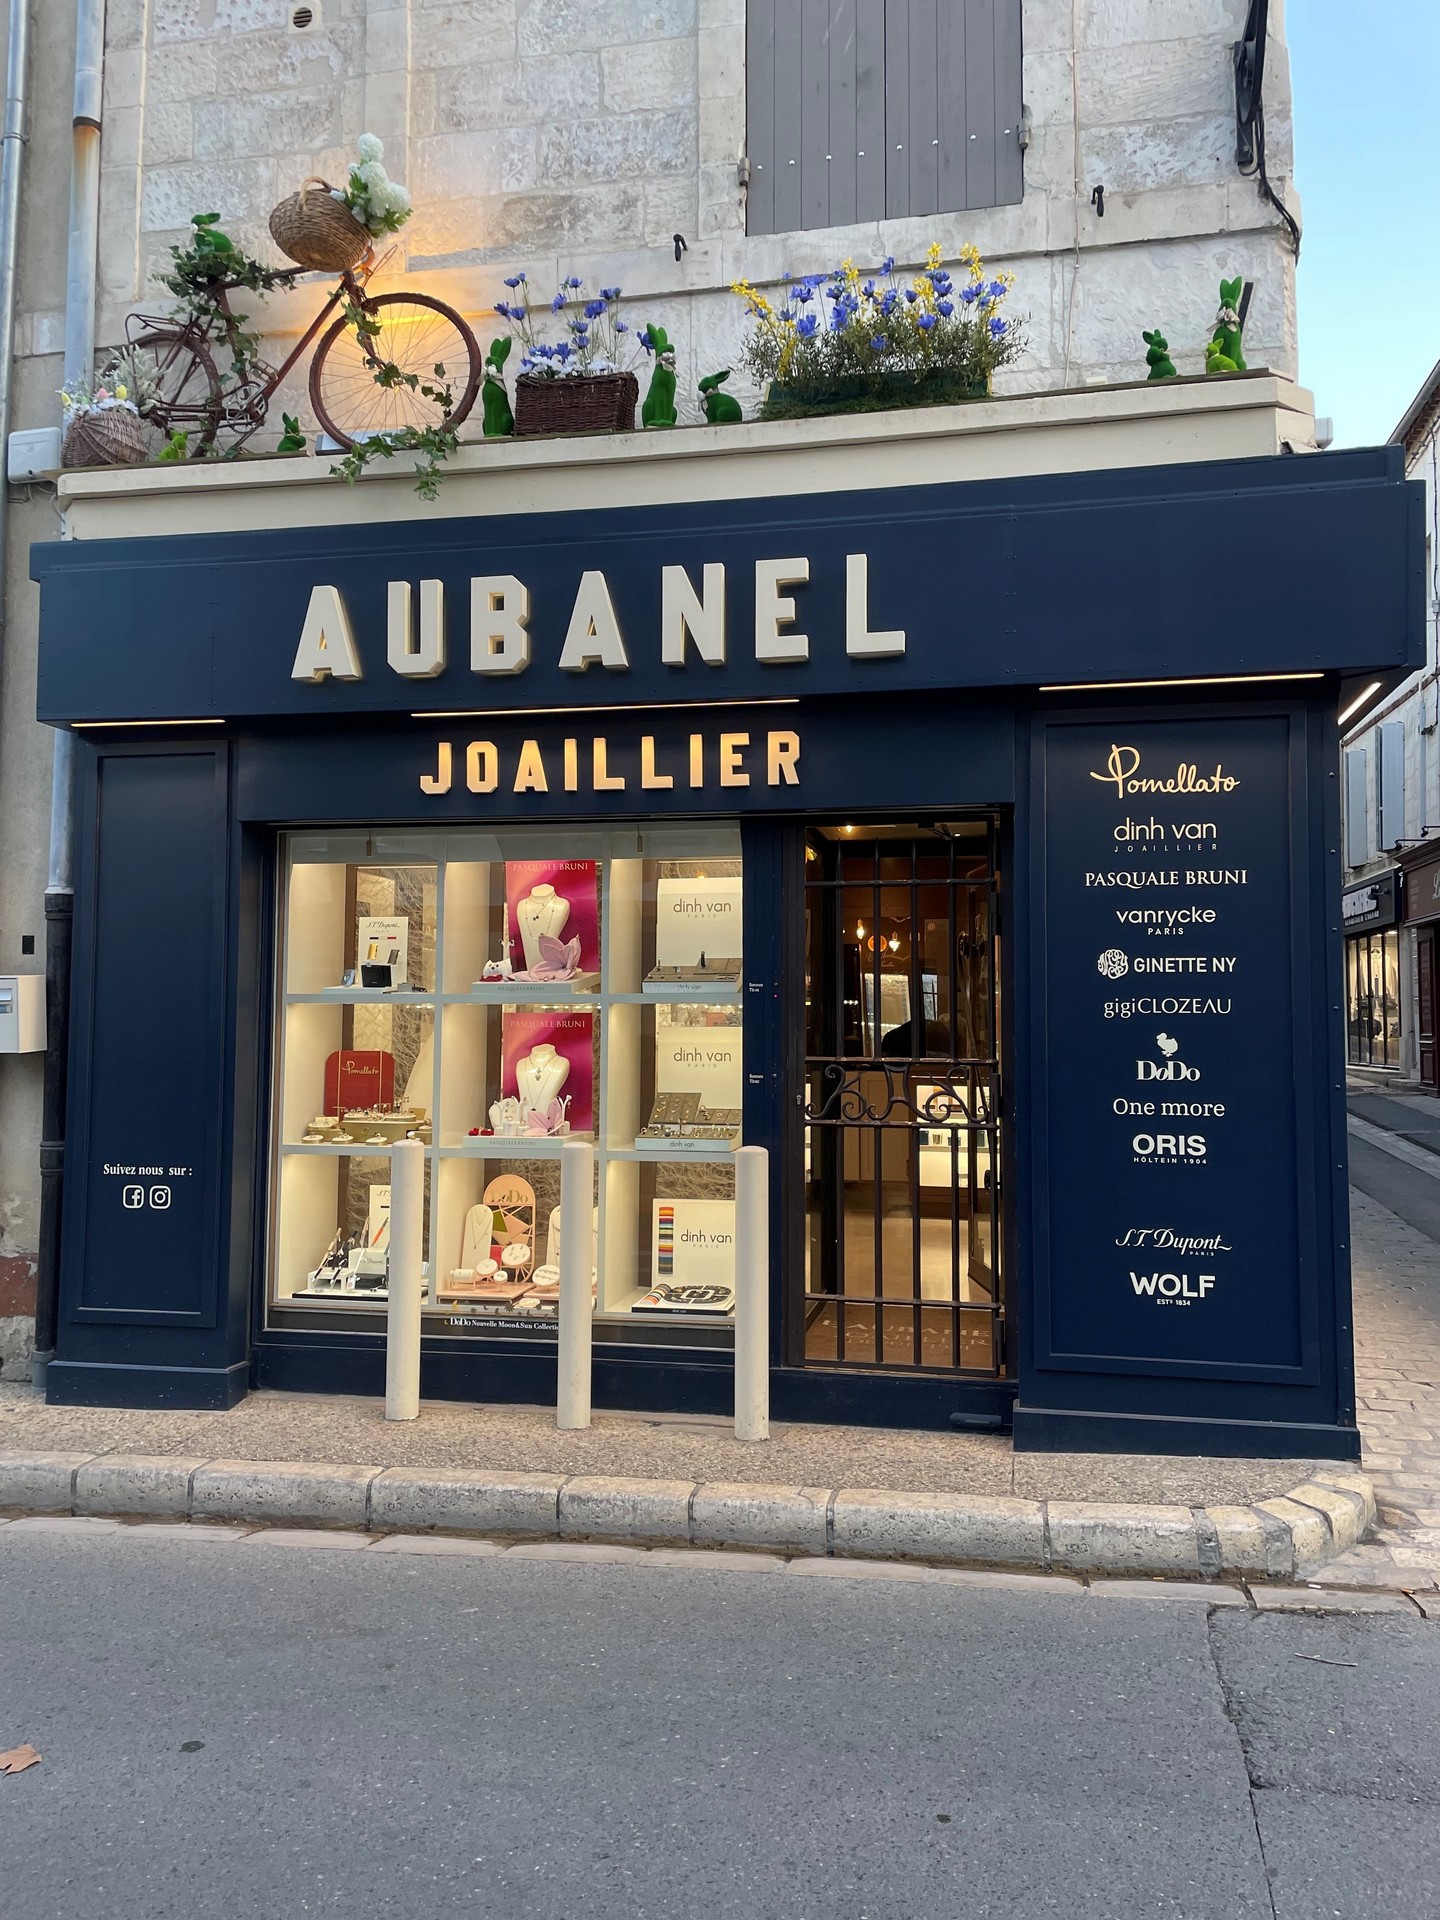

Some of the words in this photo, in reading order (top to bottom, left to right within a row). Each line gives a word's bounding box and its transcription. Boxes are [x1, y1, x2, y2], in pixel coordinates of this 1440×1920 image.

[291, 553, 906, 682] AUBANEL
[420, 731, 800, 795] JOAILLIER
[1090, 744, 1240, 799] Pomellato
[1114, 817, 1164, 841] dinh
[1172, 823, 1217, 839] van
[1114, 843, 1217, 852] JOAILLIER
[513, 863, 557, 872] PASQUALE
[559, 862, 588, 871] BRUNI
[1085, 871, 1179, 889] PASQUALE
[1185, 870, 1248, 885] BRUNI
[673, 898, 702, 913] dinh
[706, 903, 731, 912] van
[1116, 906, 1216, 926] vanrycke
[1148, 927, 1184, 935] PARIS
[1134, 957, 1207, 973] GINETTE
[1212, 957, 1236, 973] NY
[1104, 998, 1232, 1018] gigiCLOZEAU
[510, 1020, 554, 1030] PASQUALE
[556, 1020, 585, 1028] BRUNI
[674, 1048, 702, 1062] dinh
[706, 1052, 732, 1062] van
[341, 1060, 379, 1075] Pomellato
[1136, 1060, 1201, 1081] DoDo
[1113, 1098, 1155, 1115] One
[1161, 1102, 1225, 1117] more
[1132, 1134, 1207, 1156] ORIS
[103, 1163, 137, 1175] Suivez
[138, 1166, 164, 1176] nous
[168, 1167, 187, 1176] sur
[490, 1189, 529, 1204] DoDo
[680, 1229, 706, 1242] dinh
[710, 1234, 732, 1243] van
[1153, 1228, 1232, 1256] Dupont
[1129, 1271, 1216, 1298] WOLF
[450, 1317, 471, 1326] DoDo
[471, 1320, 498, 1328] Nouvelle
[498, 1321, 533, 1330] Moon&Sun
[533, 1322, 559, 1331] Collectio
